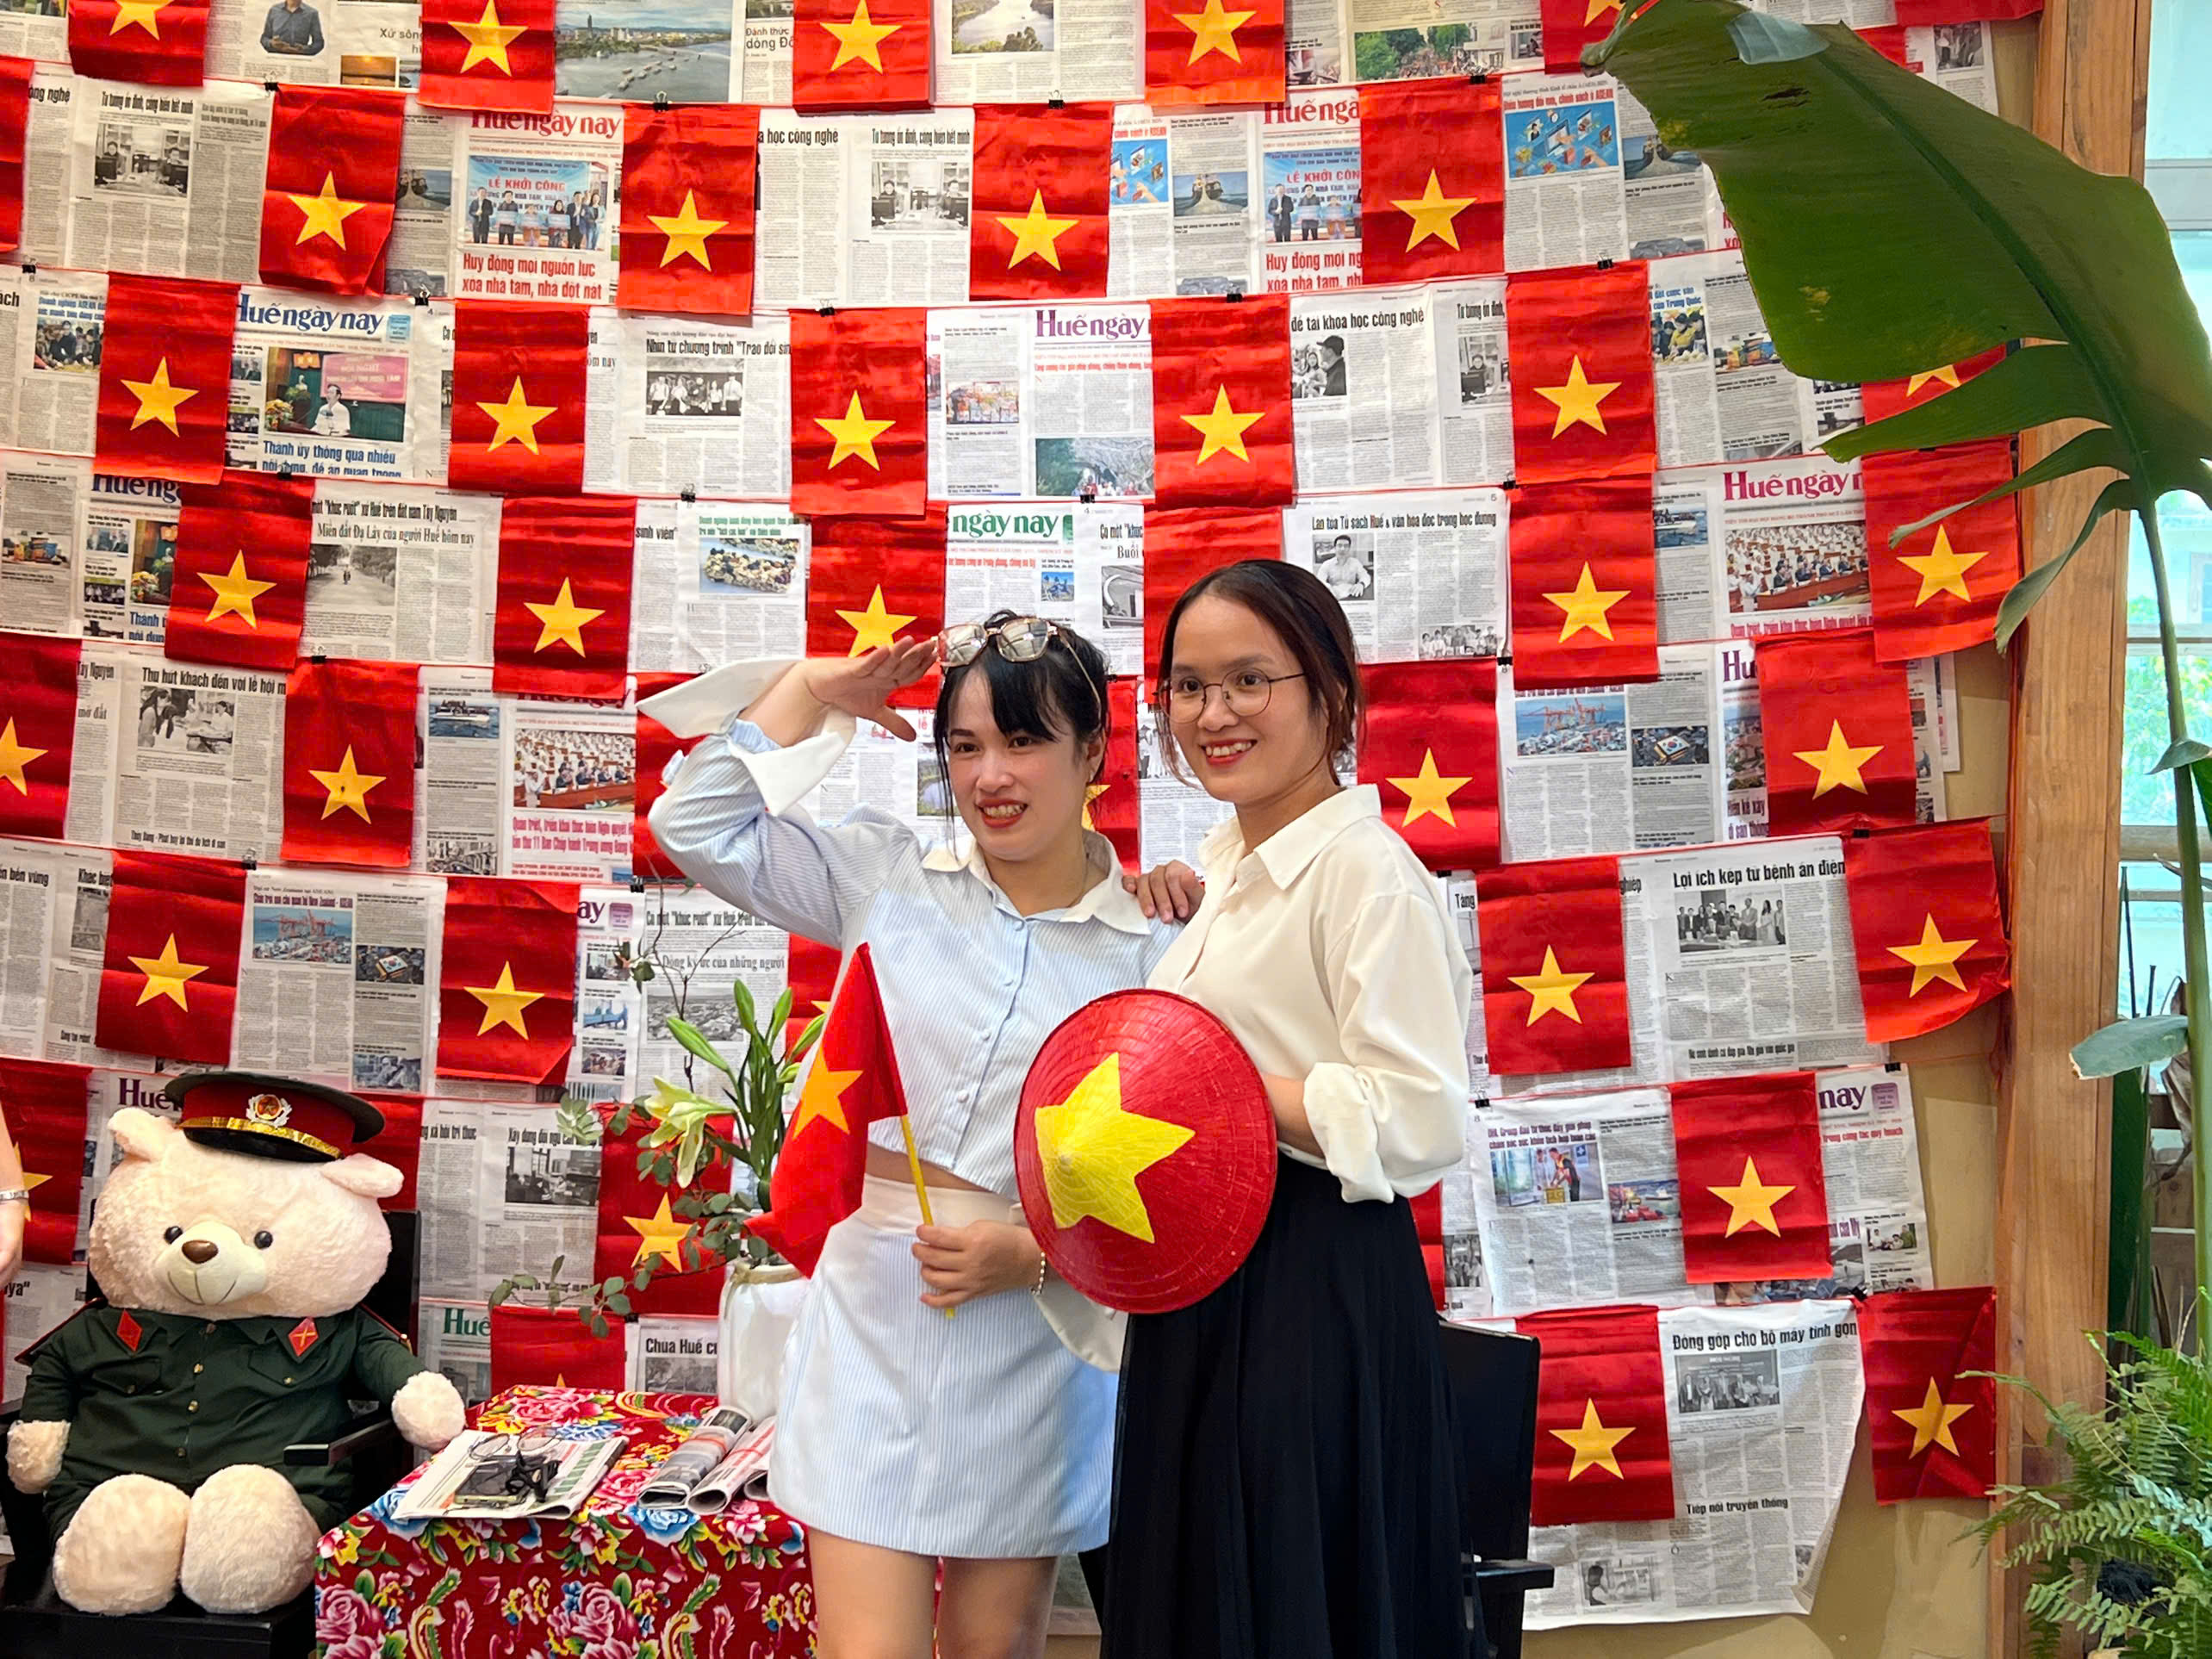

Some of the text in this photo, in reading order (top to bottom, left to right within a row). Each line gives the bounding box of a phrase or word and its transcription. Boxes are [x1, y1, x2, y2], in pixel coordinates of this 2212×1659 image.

[400, 28, 422, 39] sôn
[463, 252, 483, 273] Huy
[1266, 253, 1288, 272] Huy
